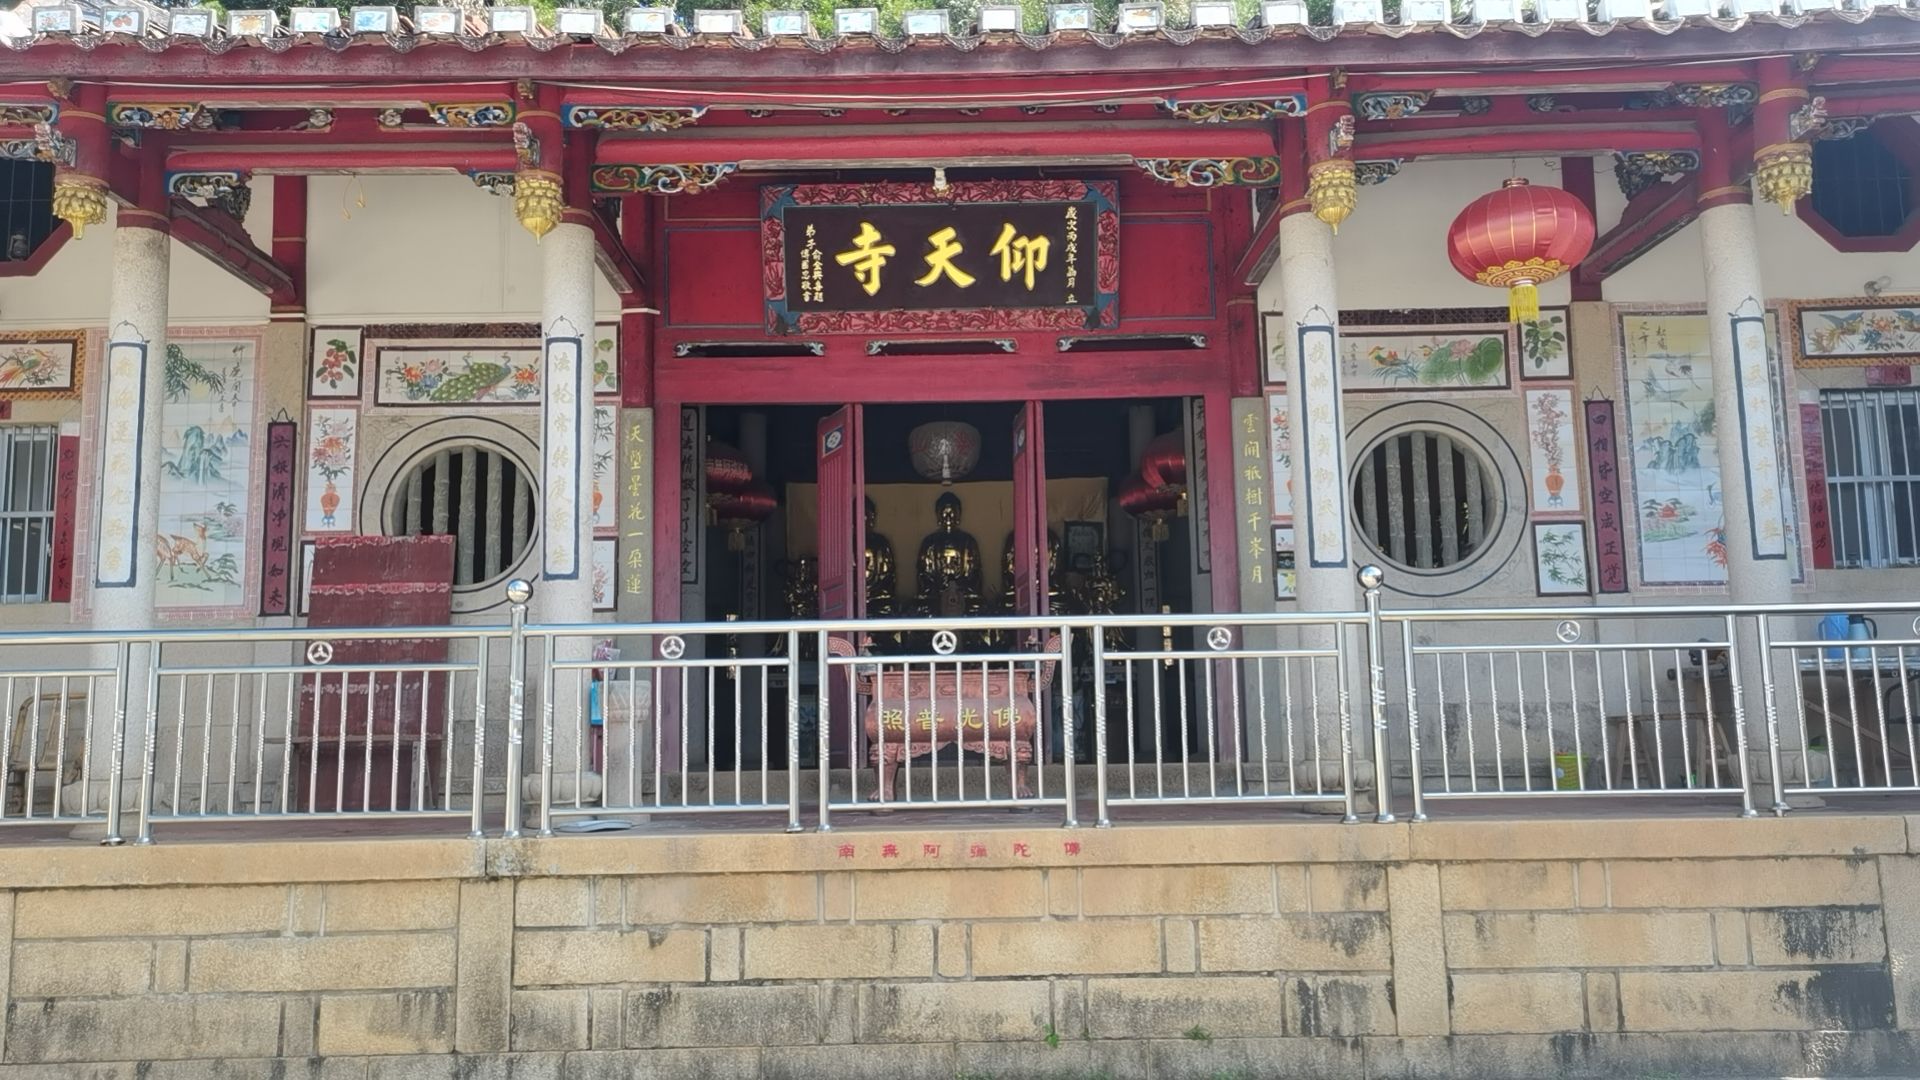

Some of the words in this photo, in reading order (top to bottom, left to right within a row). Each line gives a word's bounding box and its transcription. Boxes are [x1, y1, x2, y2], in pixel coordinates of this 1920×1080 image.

[834, 221, 1050, 296] 仰天寺
[882, 707, 1021, 731] 佛光普照
